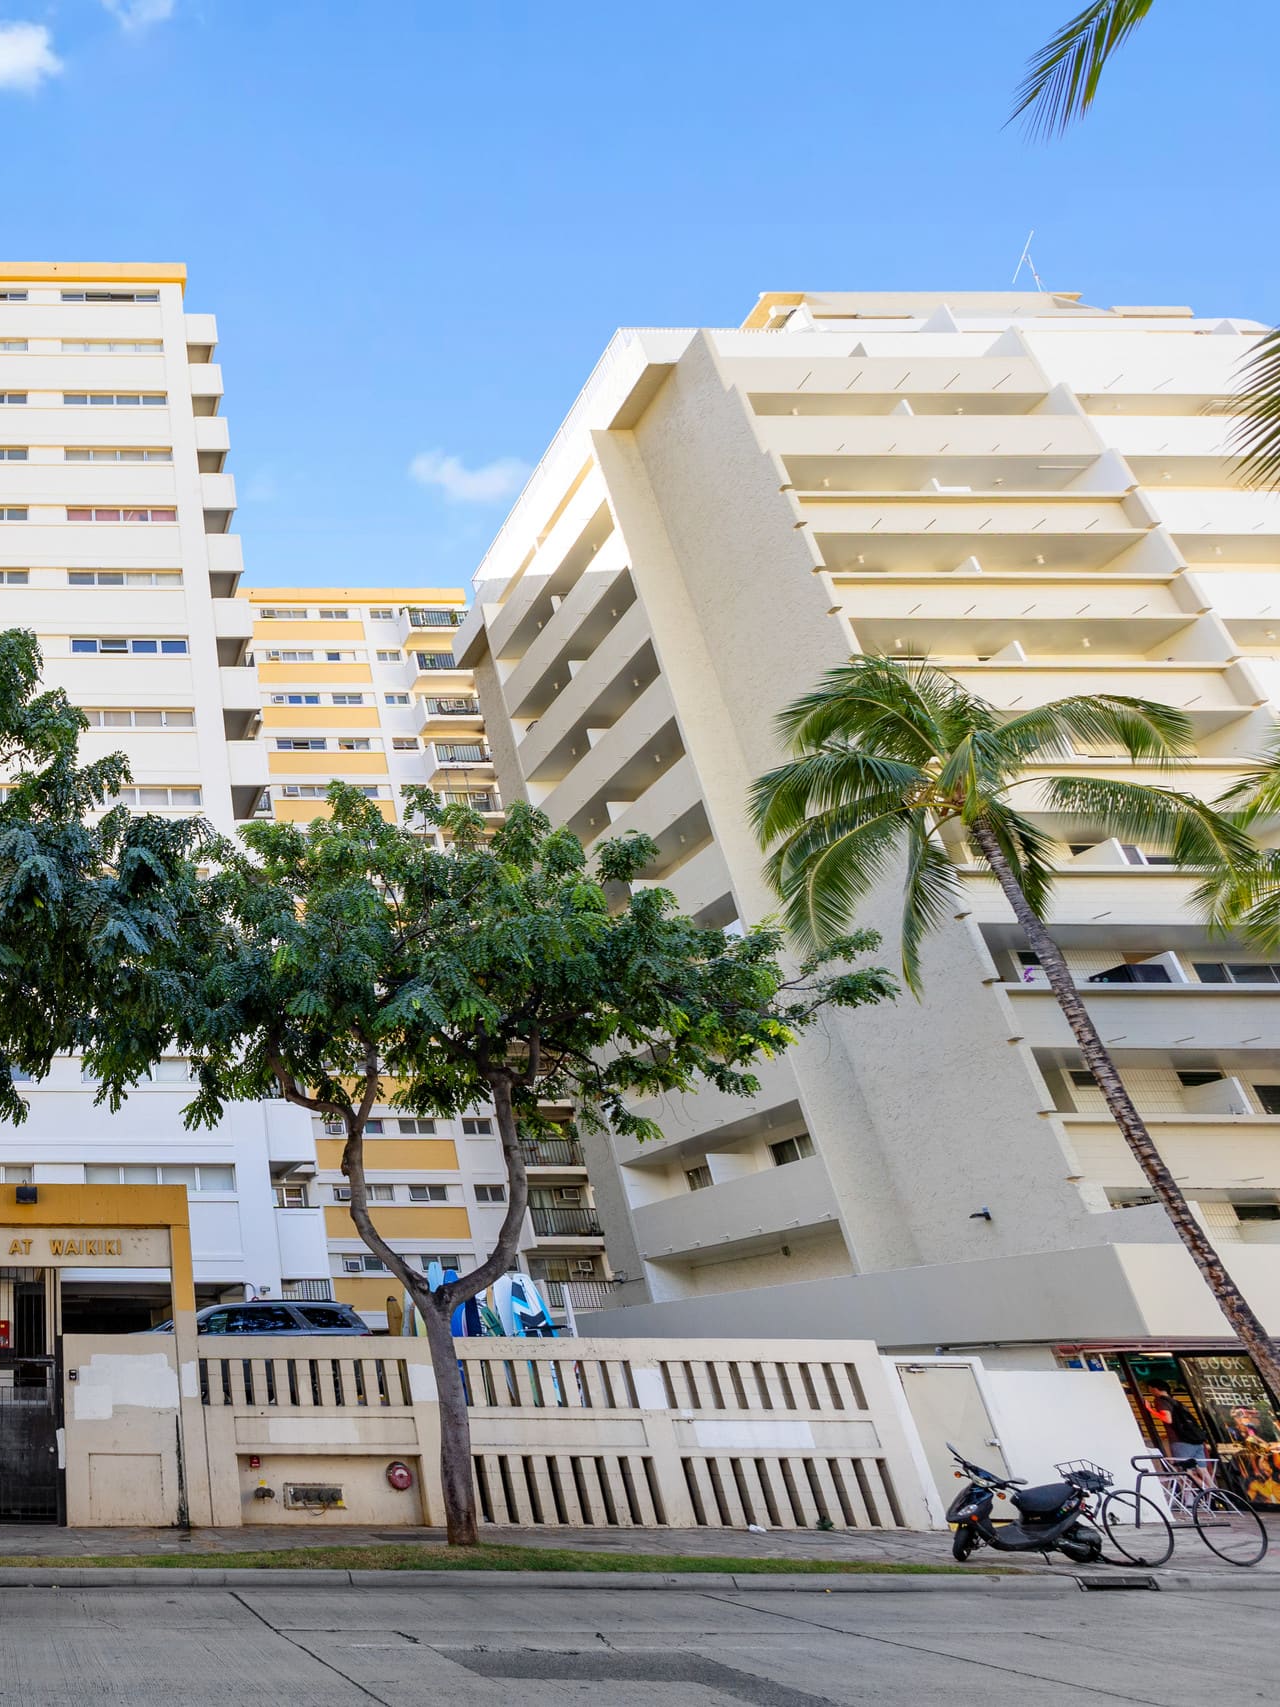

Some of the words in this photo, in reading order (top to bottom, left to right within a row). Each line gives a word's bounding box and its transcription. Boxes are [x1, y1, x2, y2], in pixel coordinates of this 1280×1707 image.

[9, 1239, 33, 1255] AT
[49, 1239, 122, 1256] WAIKIKI
[1198, 1357, 1245, 1370] BOOK
